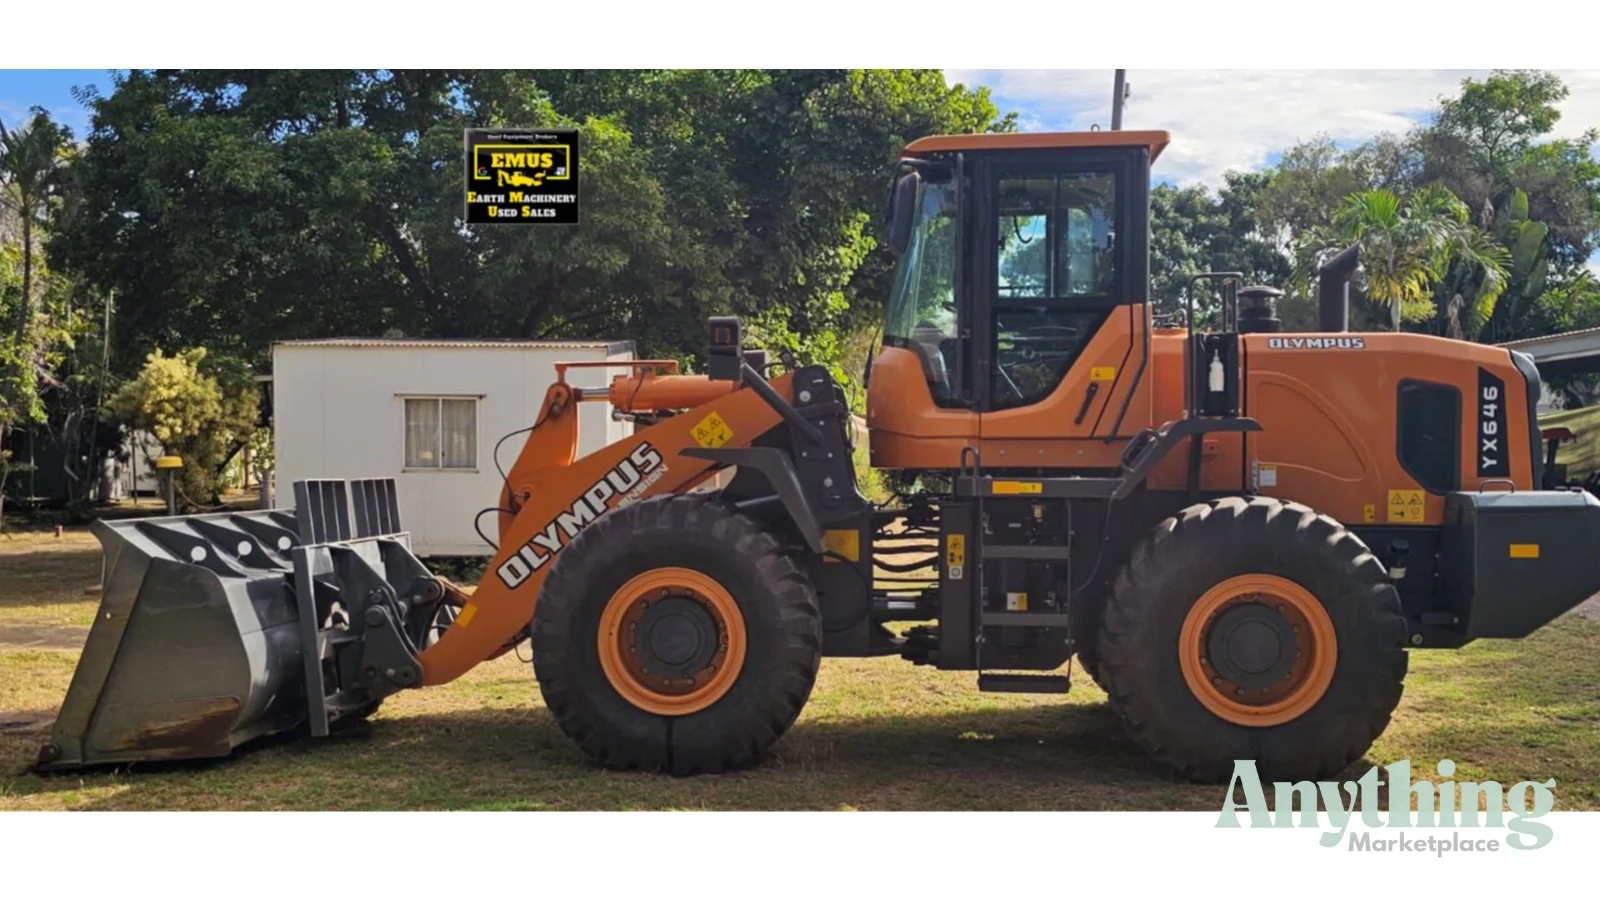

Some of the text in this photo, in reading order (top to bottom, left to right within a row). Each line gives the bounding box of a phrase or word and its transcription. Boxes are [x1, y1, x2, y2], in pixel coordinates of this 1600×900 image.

[1267, 337, 1365, 349] OLYMPUS
[1482, 385, 1498, 469] YX646
[496, 440, 664, 590] OLYMPUS
